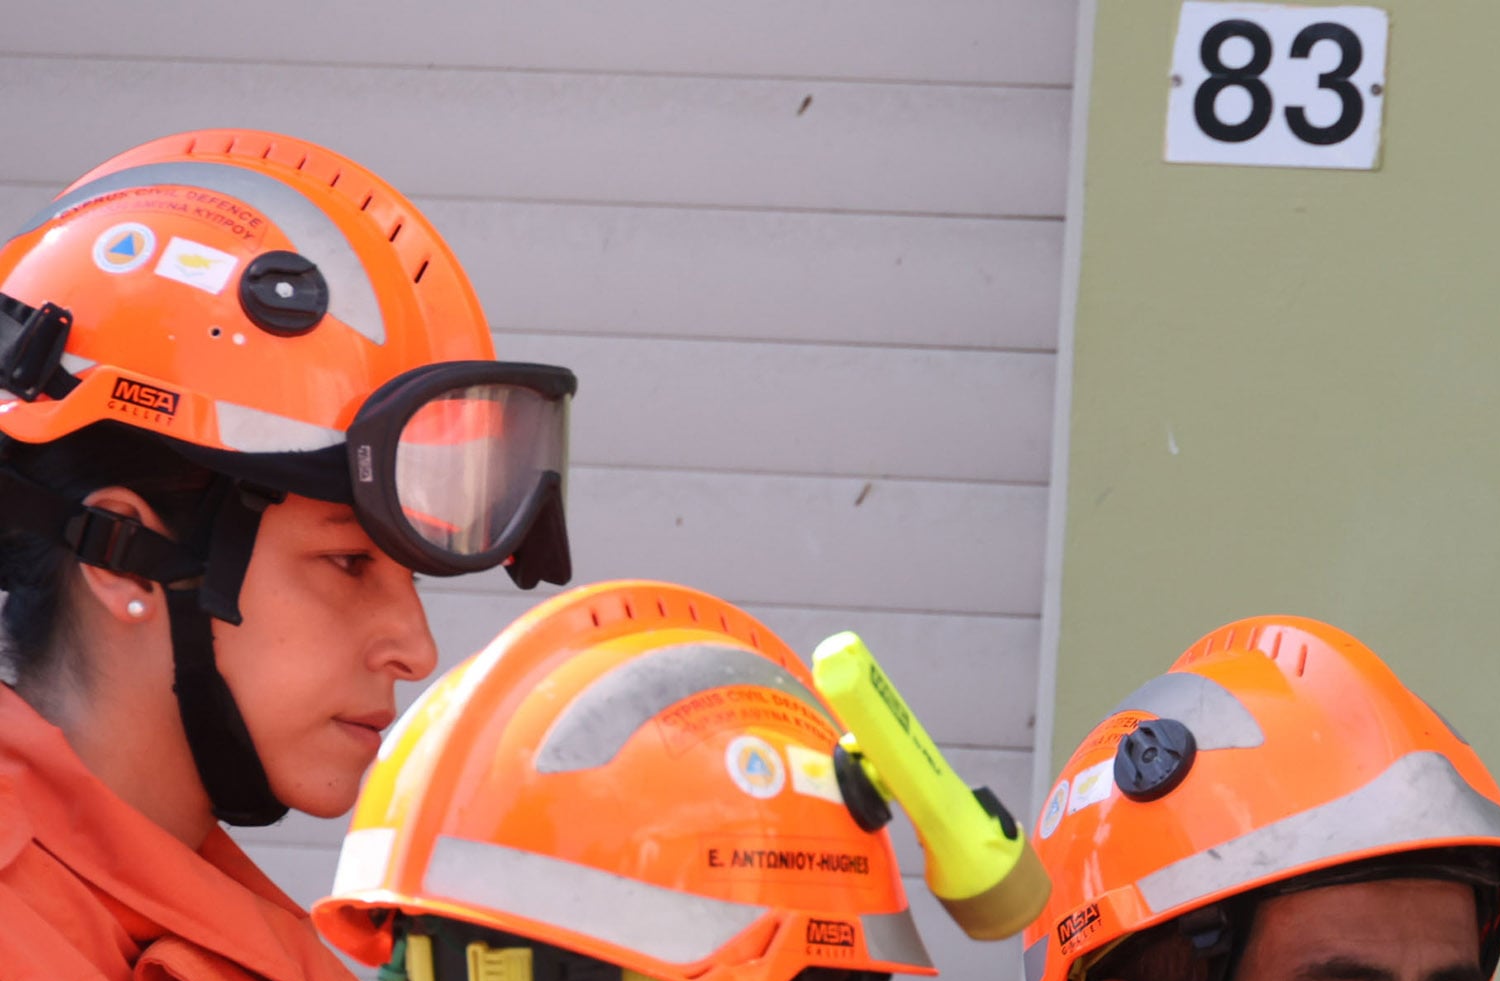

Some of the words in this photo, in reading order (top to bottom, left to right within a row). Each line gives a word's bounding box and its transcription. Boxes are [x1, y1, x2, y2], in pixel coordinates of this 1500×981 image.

[1193, 18, 1365, 146] 83
[186, 189, 264, 229] DEFENCE
[112, 379, 178, 415] MSA
[807, 919, 855, 947] MSA
[1058, 904, 1100, 946] MSA
